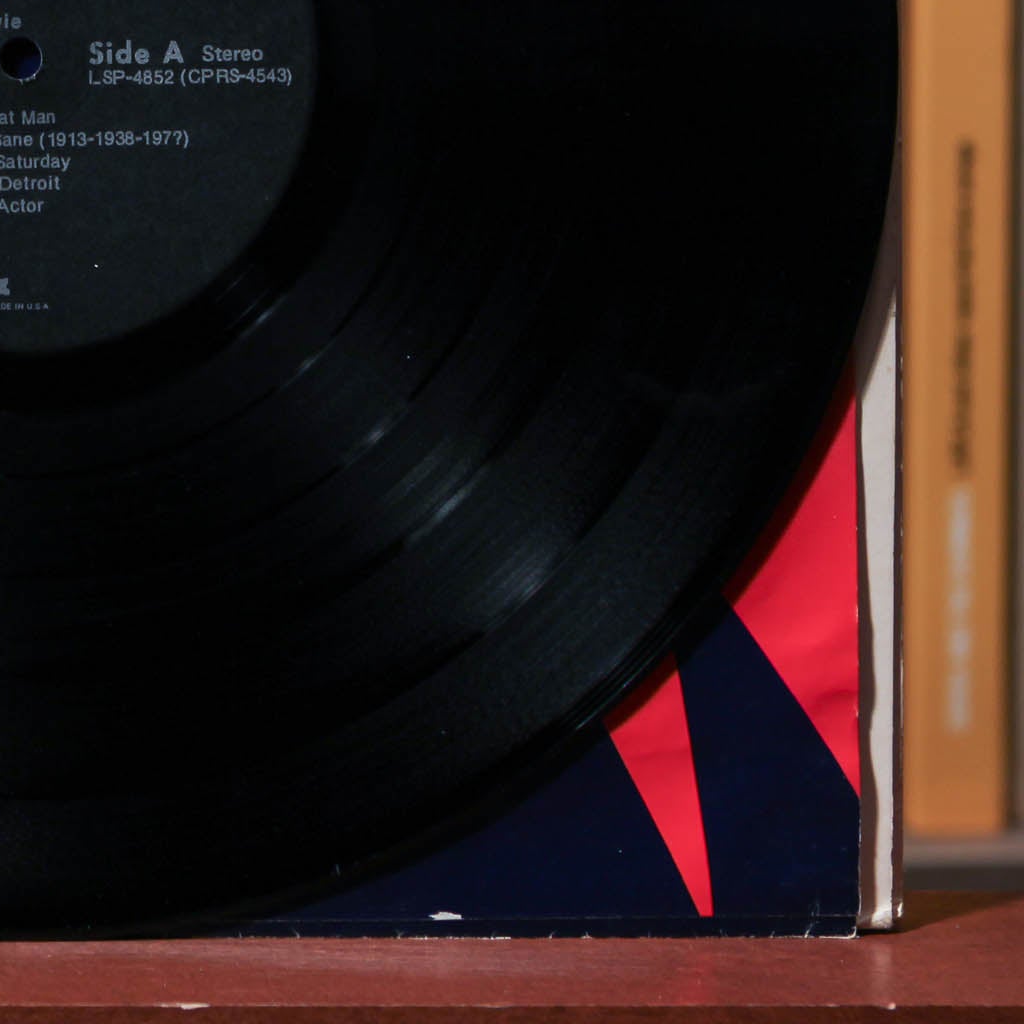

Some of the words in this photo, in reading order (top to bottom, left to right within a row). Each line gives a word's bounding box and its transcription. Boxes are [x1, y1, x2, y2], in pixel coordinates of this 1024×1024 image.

[90, 40, 149, 64] Side
[163, 41, 184, 63] A
[203, 45, 263, 62] Stereo
[89, 70, 174, 84] LSP-4852
[181, 68, 292, 87] (CPRS-4543)
[22, 111, 55, 125] Man
[0, 176, 60, 191] Detroit
